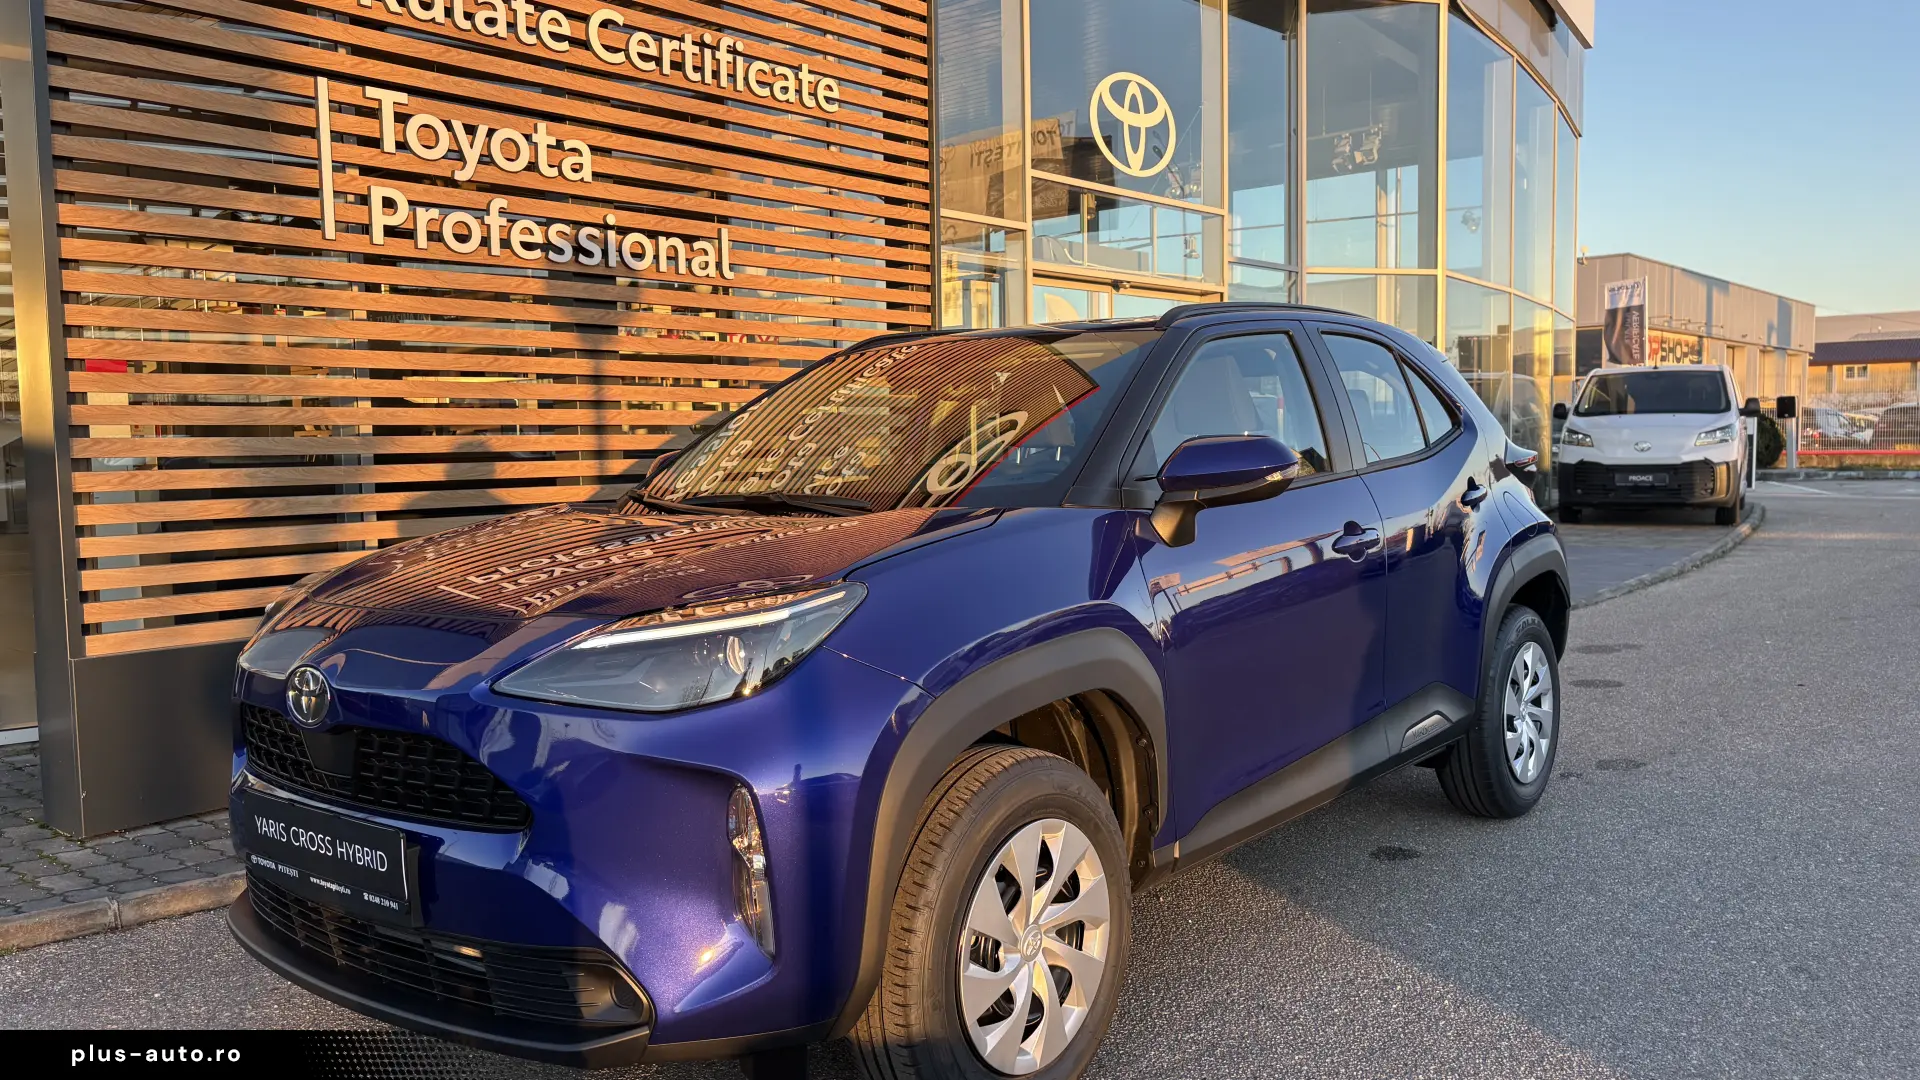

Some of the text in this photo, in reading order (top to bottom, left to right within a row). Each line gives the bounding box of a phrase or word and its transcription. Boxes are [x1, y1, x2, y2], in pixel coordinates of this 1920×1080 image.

[586, 8, 840, 113] Certificate
[363, 86, 592, 183] Toyota
[368, 186, 735, 281] Professional
[254, 815, 388, 872] YARIS CROSS HYBRID
[257, 856, 276, 870] TOYOTA
